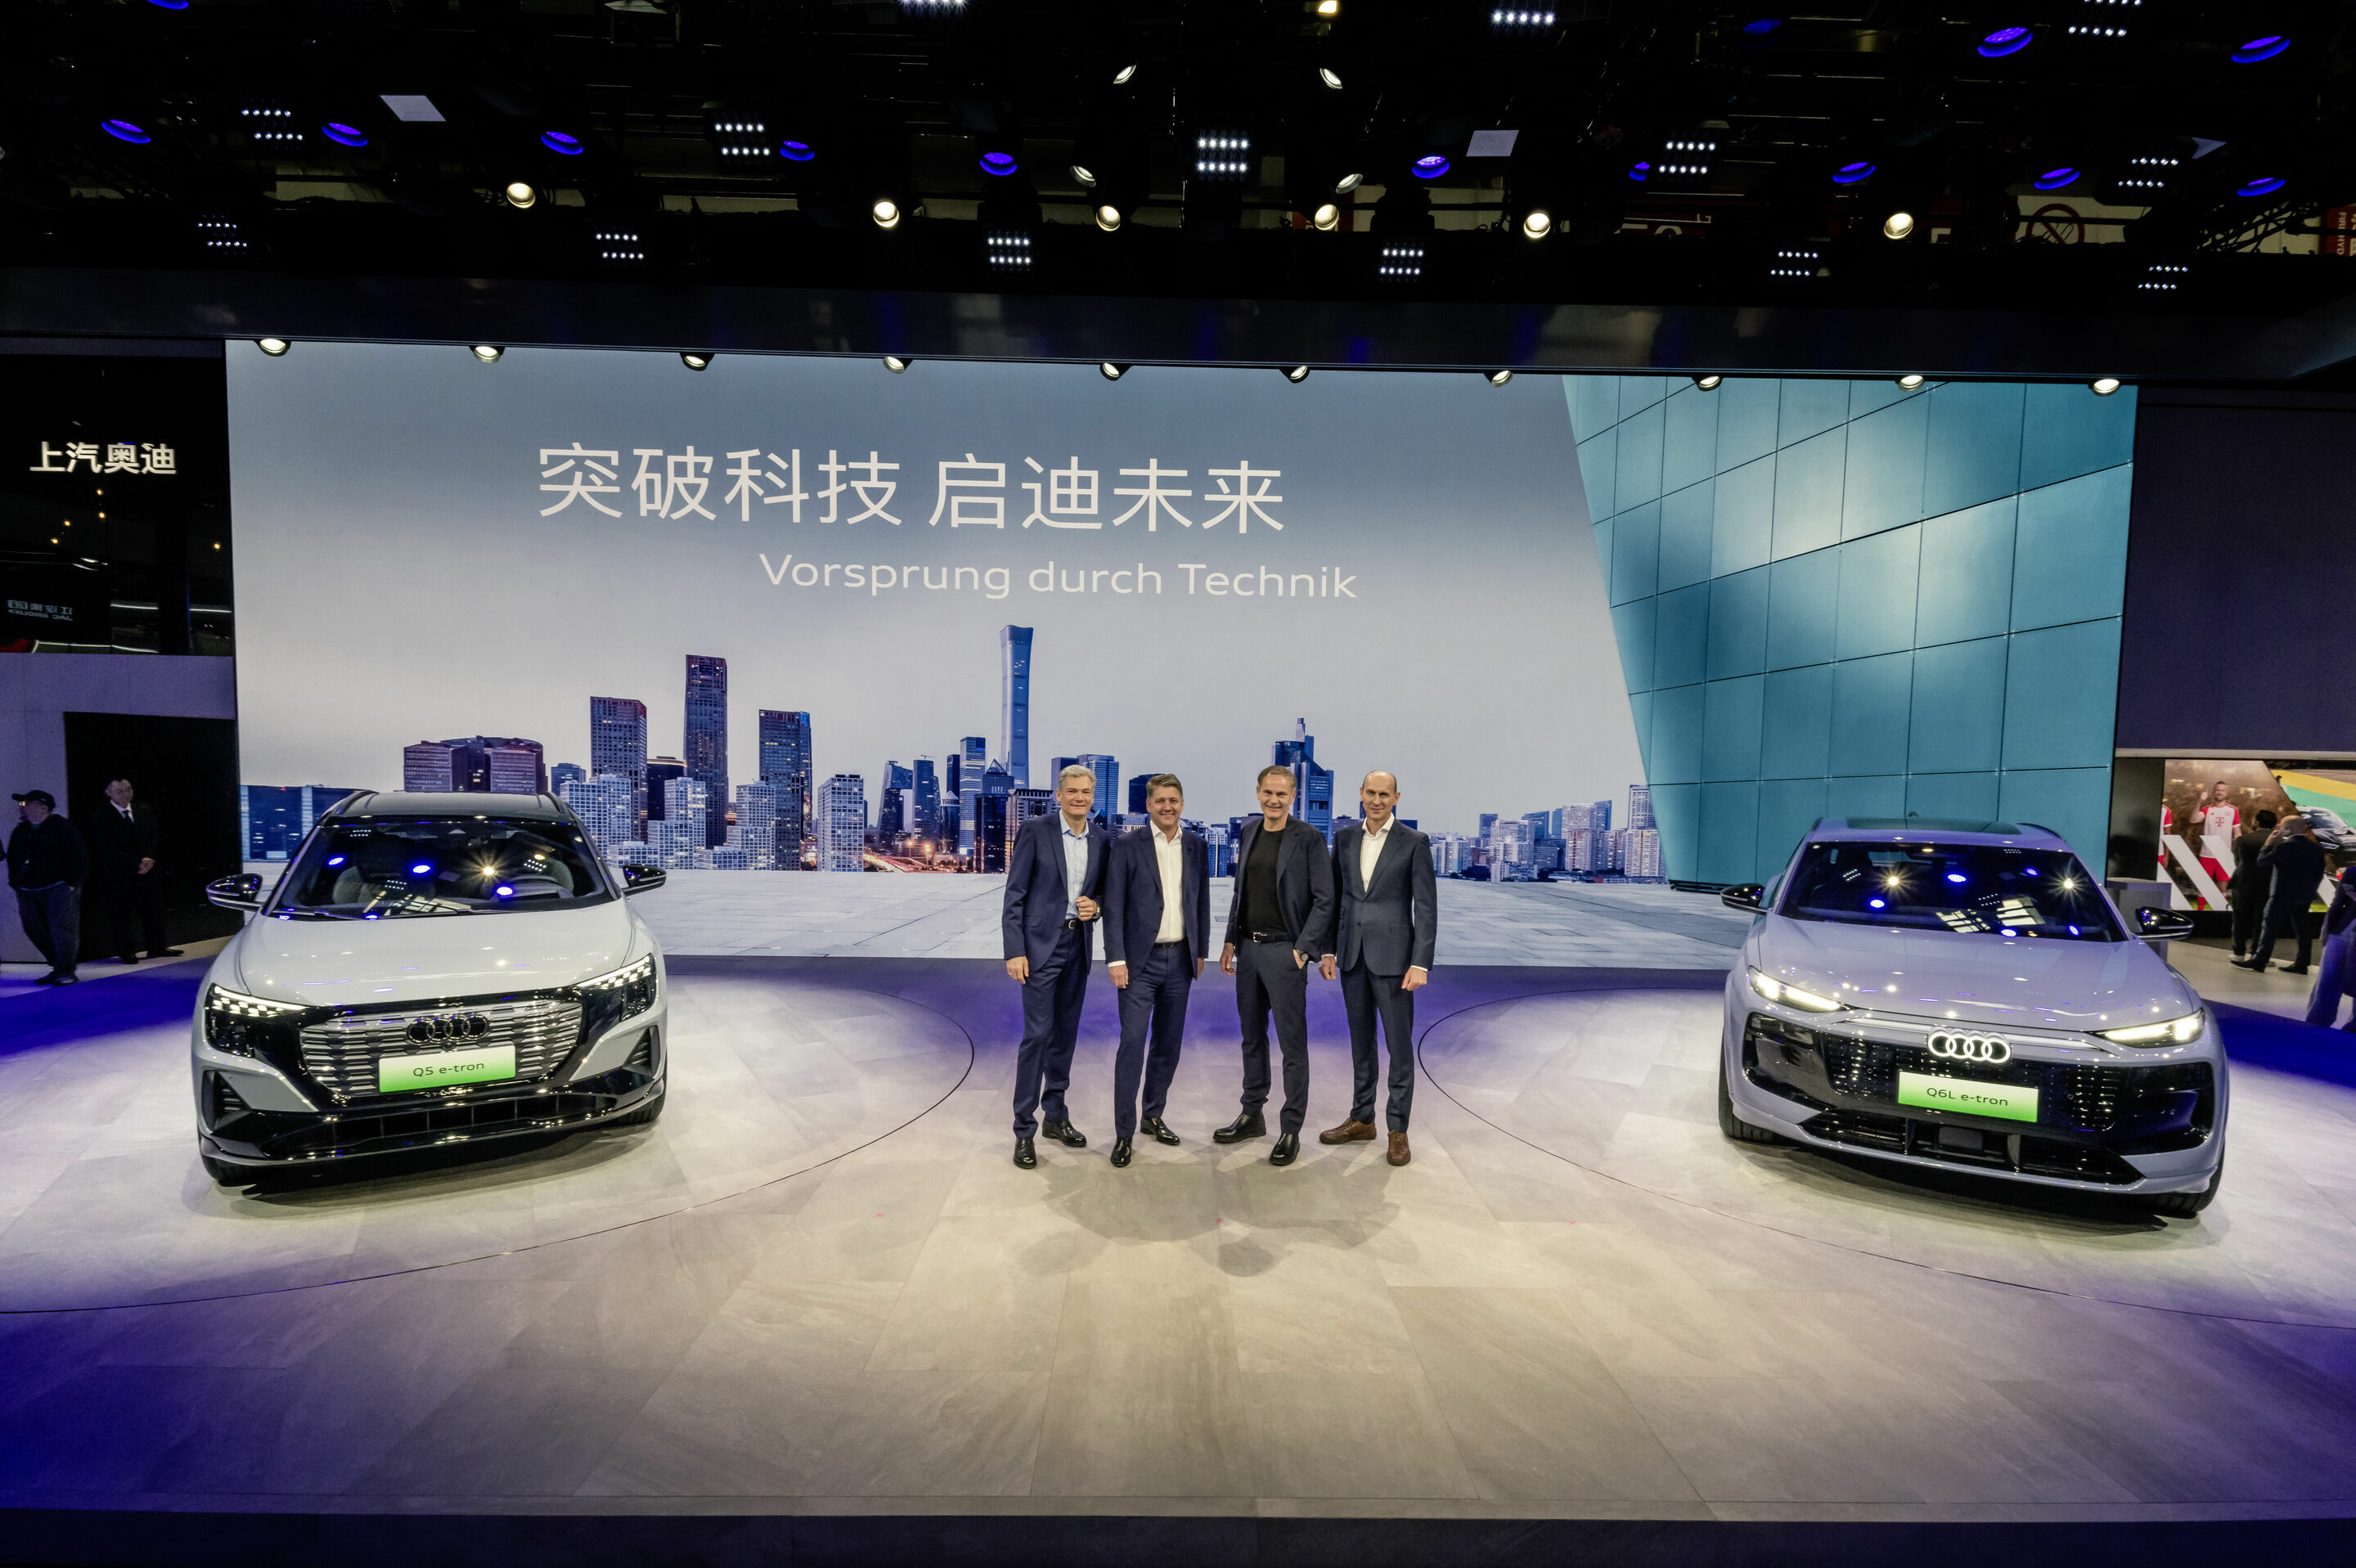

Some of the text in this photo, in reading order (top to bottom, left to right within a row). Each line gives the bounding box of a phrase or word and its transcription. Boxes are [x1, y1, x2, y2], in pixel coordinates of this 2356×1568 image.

[29, 441, 177, 474] 上汽奥迪
[539, 442, 1284, 534] 突破科技 启迪未来
[759, 554, 1358, 600] Vorsprung durch Technik
[412, 1062, 485, 1077] Q5 e-tron
[1927, 1087, 2008, 1106] Q6L e-tron
